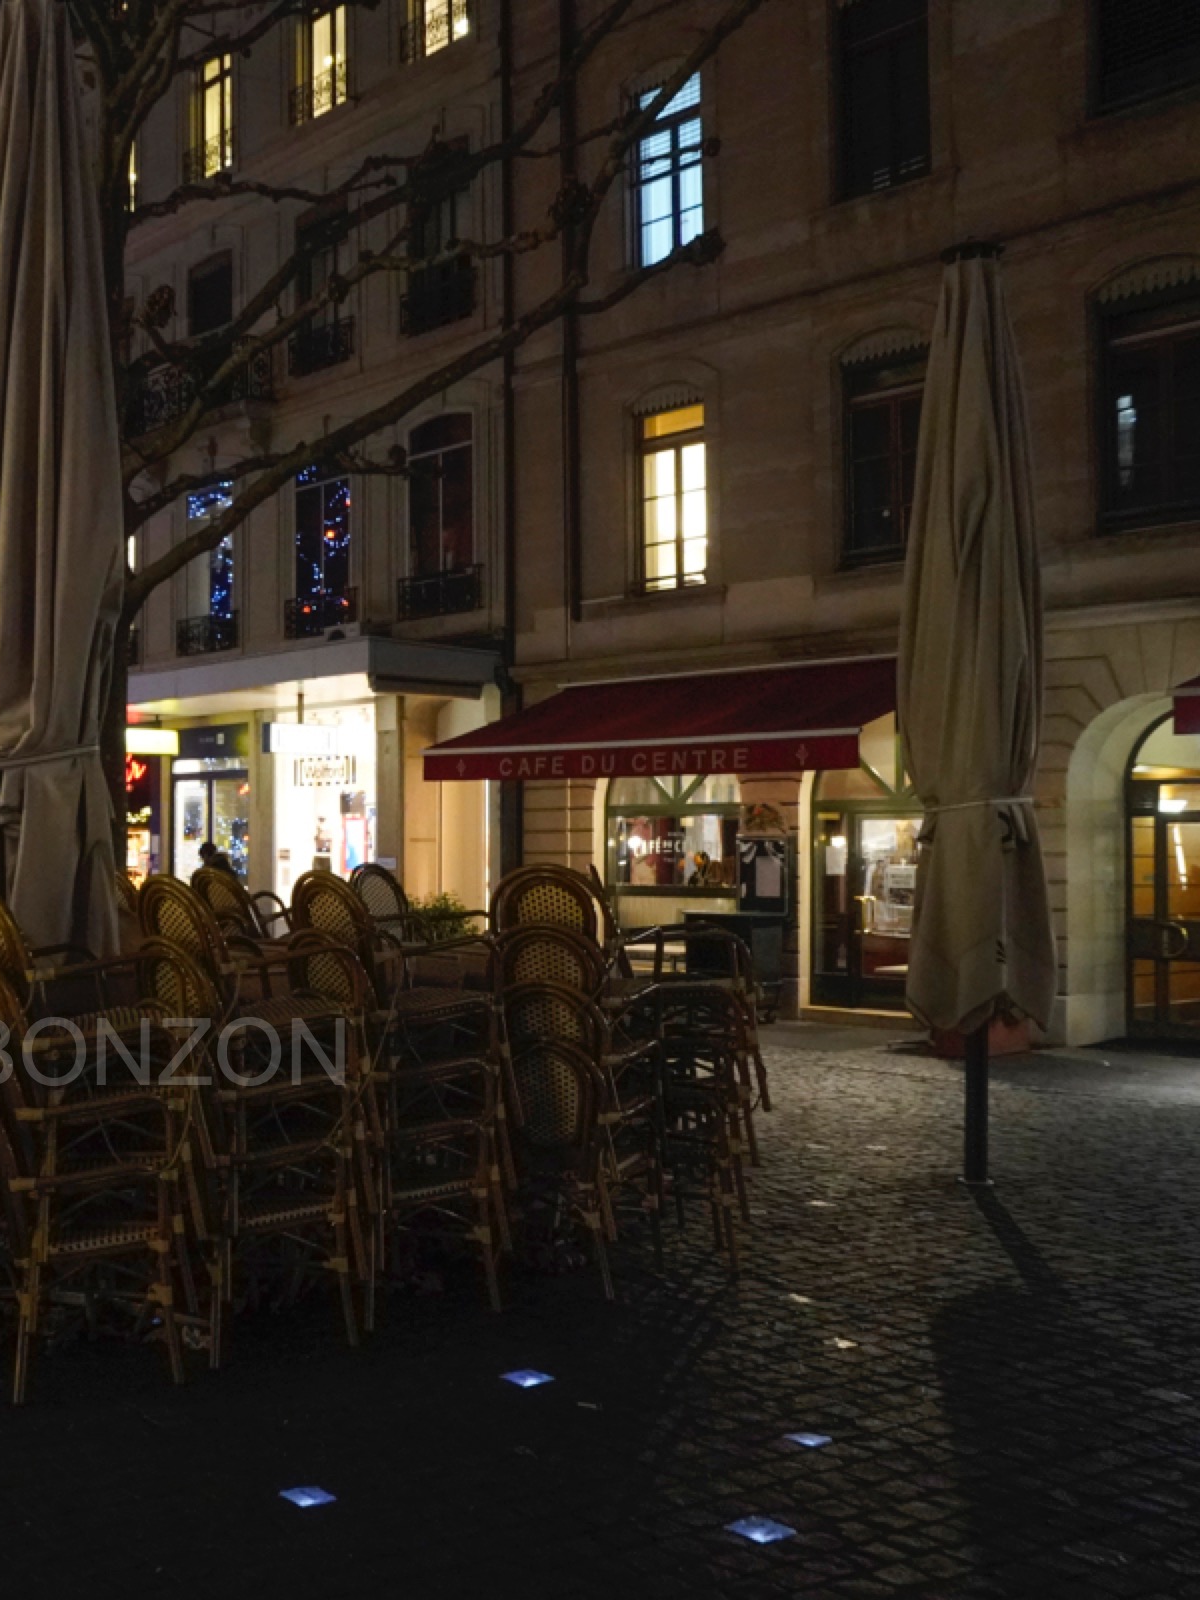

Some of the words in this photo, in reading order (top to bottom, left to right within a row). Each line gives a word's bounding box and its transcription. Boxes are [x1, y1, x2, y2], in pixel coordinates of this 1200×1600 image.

[500, 755, 565, 776] CAFE
[581, 752, 616, 773] DU
[631, 748, 748, 772] CENTRE
